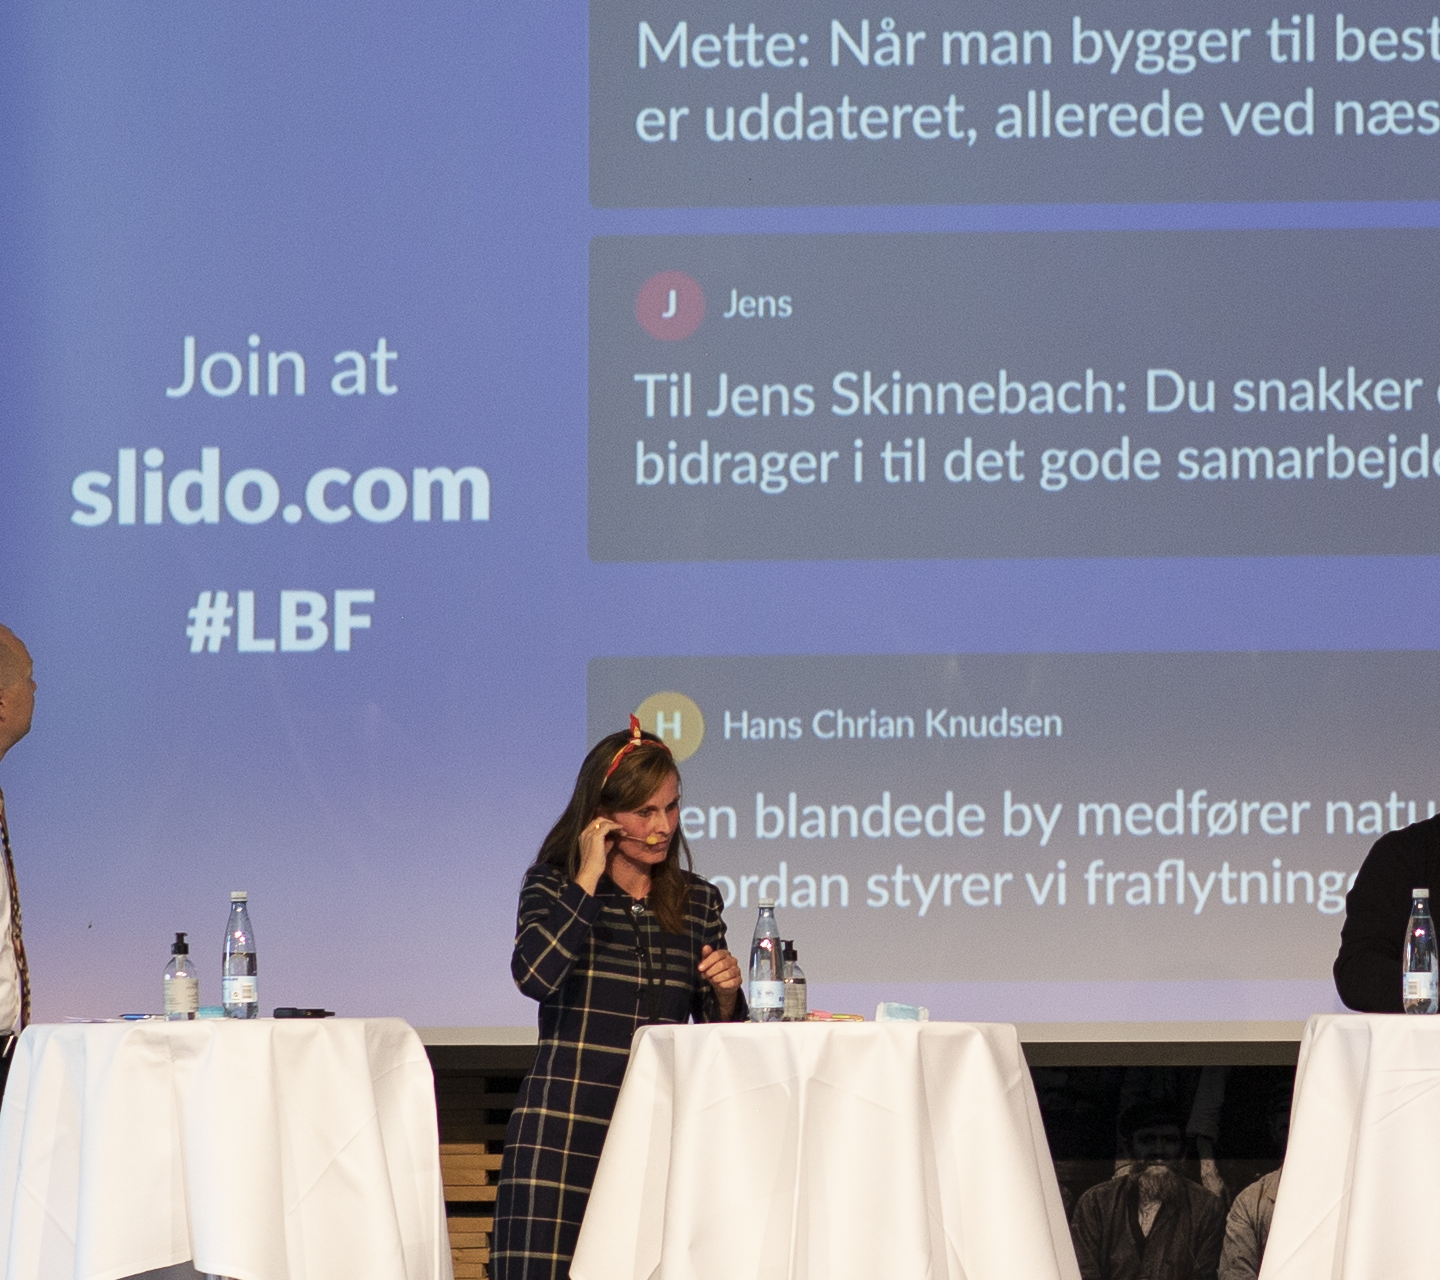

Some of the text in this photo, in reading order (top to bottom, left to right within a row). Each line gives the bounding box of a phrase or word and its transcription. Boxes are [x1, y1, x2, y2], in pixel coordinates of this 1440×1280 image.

[638, 20, 810, 69] Mette:
[830, 16, 927, 68] Når
[942, 29, 1053, 67] man
[1072, 15, 1252, 76] bygger
[1265, 12, 1316, 64] til
[635, 106, 690, 143] er
[705, 91, 978, 147] uddateret,
[994, 87, 1205, 140] allerede
[1219, 86, 1315, 137] ved
[723, 288, 793, 319] Jens
[165, 333, 399, 399] Join at
[633, 371, 692, 418] Til
[706, 372, 816, 418] Jens
[831, 367, 1127, 417] Skinnebach:
[1146, 368, 1216, 414] Du
[1232, 365, 1424, 413] snakker
[70, 446, 491, 528] slido.com
[635, 439, 840, 495] bidrager
[853, 437, 864, 484] i
[880, 436, 926, 484] til
[943, 436, 1026, 483] det
[1039, 434, 1162, 492] gode
[185, 588, 376, 654] #LBF
[723, 707, 1063, 740] Hans Chrian Knudsen
[679, 805, 738, 839] en
[755, 790, 986, 839] blandede
[1003, 789, 1063, 847] by
[1078, 788, 1312, 838] medfører
[712, 861, 849, 909] ordan
[866, 864, 1013, 917] styrer
[1025, 859, 1067, 906] vi
